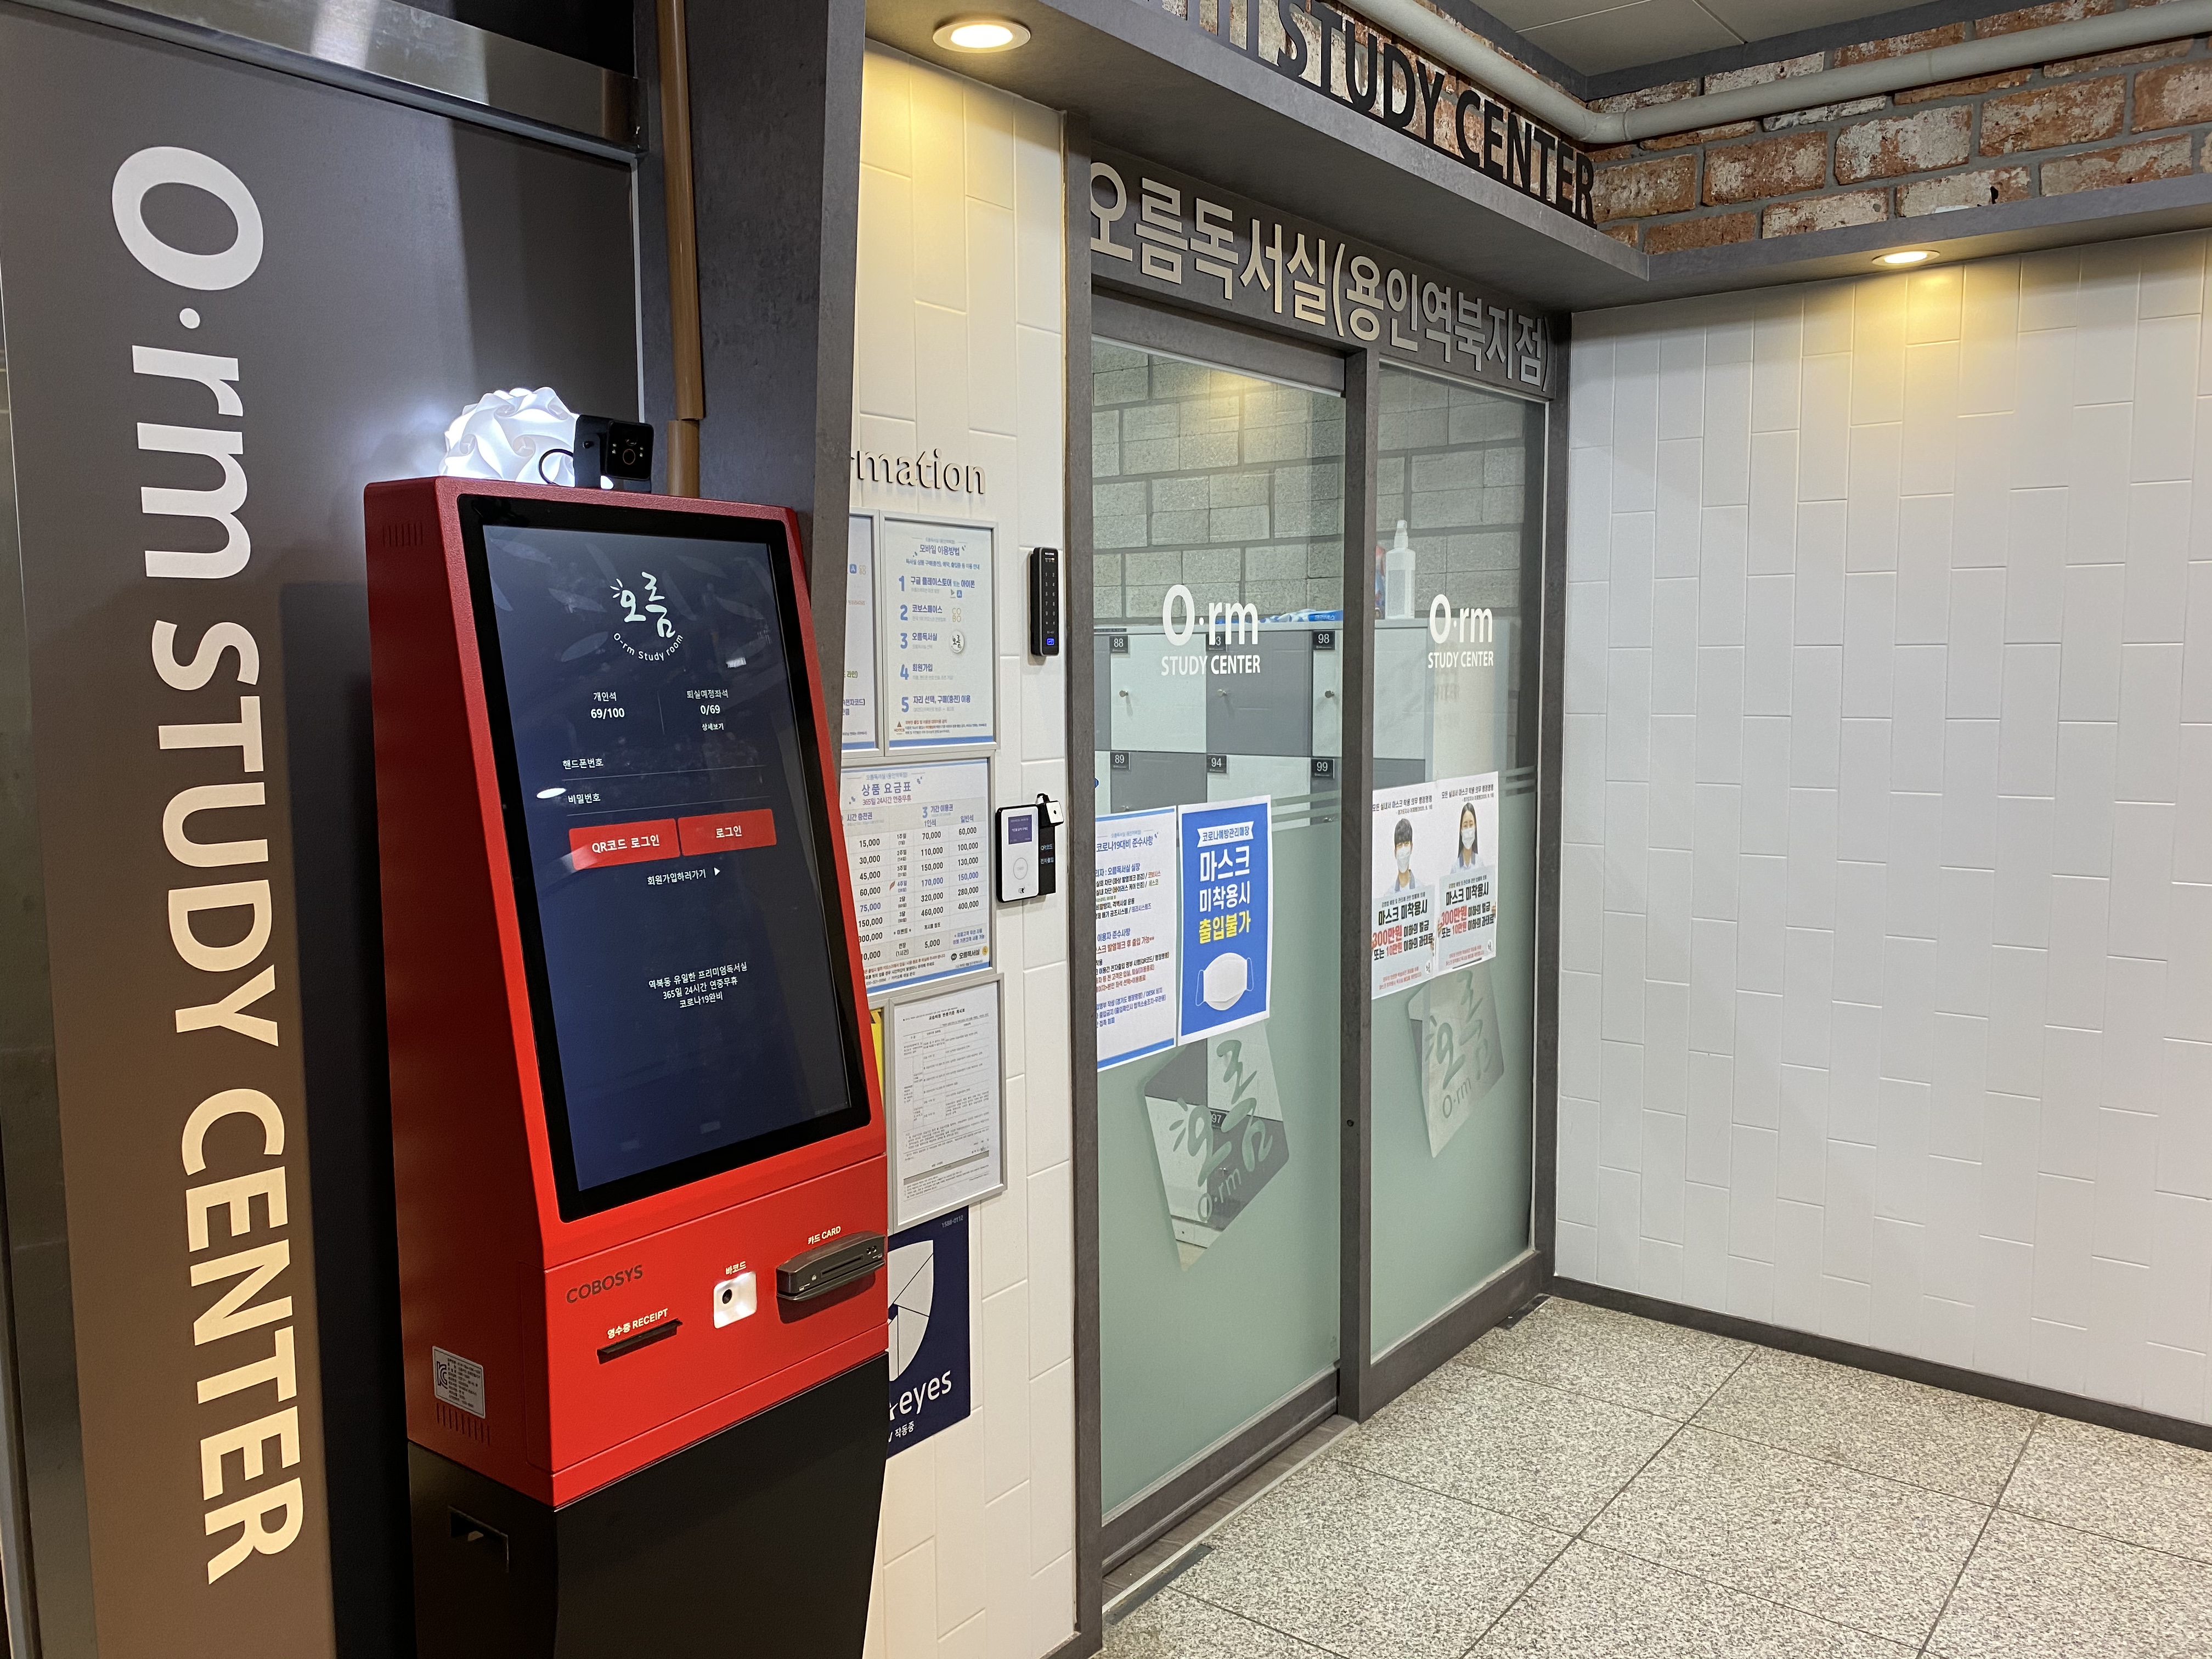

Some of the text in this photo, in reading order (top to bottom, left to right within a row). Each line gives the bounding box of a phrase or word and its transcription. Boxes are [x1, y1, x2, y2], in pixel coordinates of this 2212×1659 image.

[1278, 0, 1594, 224] STUDY CENTER
[850, 448, 985, 494] mation
[920, 544, 960, 556] 모바일 이용방법
[899, 575, 905, 591] 1
[911, 577, 921, 585] 구글
[922, 577, 951, 586] 플레이스토어
[900, 605, 908, 620] 2
[900, 633, 908, 649] 3
[912, 633, 937, 641] 오름독서실
[1114, 638, 1123, 647] 88
[1318, 634, 1329, 644] 98
[638, 651, 664, 661] Study
[666, 635, 683, 656] room
[1161, 654, 1261, 676] STUDY CENTER
[1428, 651, 1493, 668] STUDY CENTER
[900, 664, 909, 680] 4
[593, 691, 617, 703] 개인석
[686, 689, 729, 700] 퇴실예정좌석
[913, 695, 970, 704] 자리 이용
[700, 704, 721, 716] 0/69
[901, 697, 909, 712] 5
[590, 706, 625, 720] 69/100
[702, 723, 724, 731] 상세보기
[562, 758, 603, 770] 핸드폰번호
[1114, 754, 1125, 764] 89
[1211, 758, 1222, 768] 94
[1317, 761, 1328, 771] 99
[861, 781, 911, 797] 상품 요금표
[1458, 788, 1468, 796] 마스크
[567, 792, 601, 805] 비밀번호
[893, 795, 911, 803] 연중무휴
[1392, 799, 1403, 808] 마스크
[858, 812, 872, 820] 충전권
[922, 806, 928, 819] 3
[924, 819, 936, 827] 1인석
[151, 619, 279, 1047] STUDY
[715, 825, 742, 839] 로그인
[922, 831, 941, 840] 70,000
[958, 827, 977, 836] 60,000
[591, 834, 661, 853] QR코드 로그인
[859, 838, 880, 848] 15,000
[958, 842, 978, 851] 100,000
[1097, 836, 1153, 852] 코로나19대비 준수사항
[921, 847, 943, 856] 110,000
[859, 855, 880, 865] 30,000
[958, 857, 979, 866] 130,000
[1200, 845, 1250, 882] 마스크
[921, 862, 943, 871] 150,000
[1108, 863, 1140, 875] 오름독서실 실장
[647, 868, 707, 887] 회원가입하러가기
[860, 871, 881, 881] 45,000
[922, 877, 943, 887] 170,000
[958, 872, 979, 881] 150,000
[860, 887, 881, 896] 60,000
[921, 892, 944, 902] 320,000
[958, 886, 979, 896] 280,000
[1199, 881, 1250, 912] 미착용시
[1446, 882, 1489, 906] 마스크 미착용시
[860, 902, 881, 912] 75,000
[958, 900, 979, 910] 400,000
[921, 906, 944, 917] 460,000
[1378, 899, 1427, 926] 마스크 미착용시
[1441, 905, 1467, 927] 300만원
[1468, 904, 1481, 917] 이하의
[859, 917, 883, 928] 150,000
[1199, 910, 1251, 944] 출입불가
[1441, 927, 1451, 939] 또는
[1452, 921, 1467, 935] 10만원
[1468, 918, 1481, 931] 이하의
[1097, 928, 1130, 941] 이용자 준수사항
[1373, 924, 1402, 948] 300만원
[1403, 923, 1418, 938] 이하의
[924, 939, 940, 949] 5,000
[1374, 948, 1385, 961] 또는
[1386, 943, 1402, 957] 10만원
[1403, 938, 1418, 952] 이하의
[648, 961, 748, 990] 역북동 유일한 프리미엄독서실
[662, 975, 738, 1000] 365일 24시간 연중무휴
[679, 991, 724, 1009] 코로나19완비
[1212, 1114, 1222, 1123] 97
[808, 1226, 841, 1244] 카드 CARD
[725, 1260, 746, 1276] 바코드
[565, 1264, 644, 1304] COBOSYS
[607, 1308, 668, 1339] 영수증 RECEIPT
[180, 1088, 304, 1585] CENTER
[895, 1421, 914, 1437] 작동중
